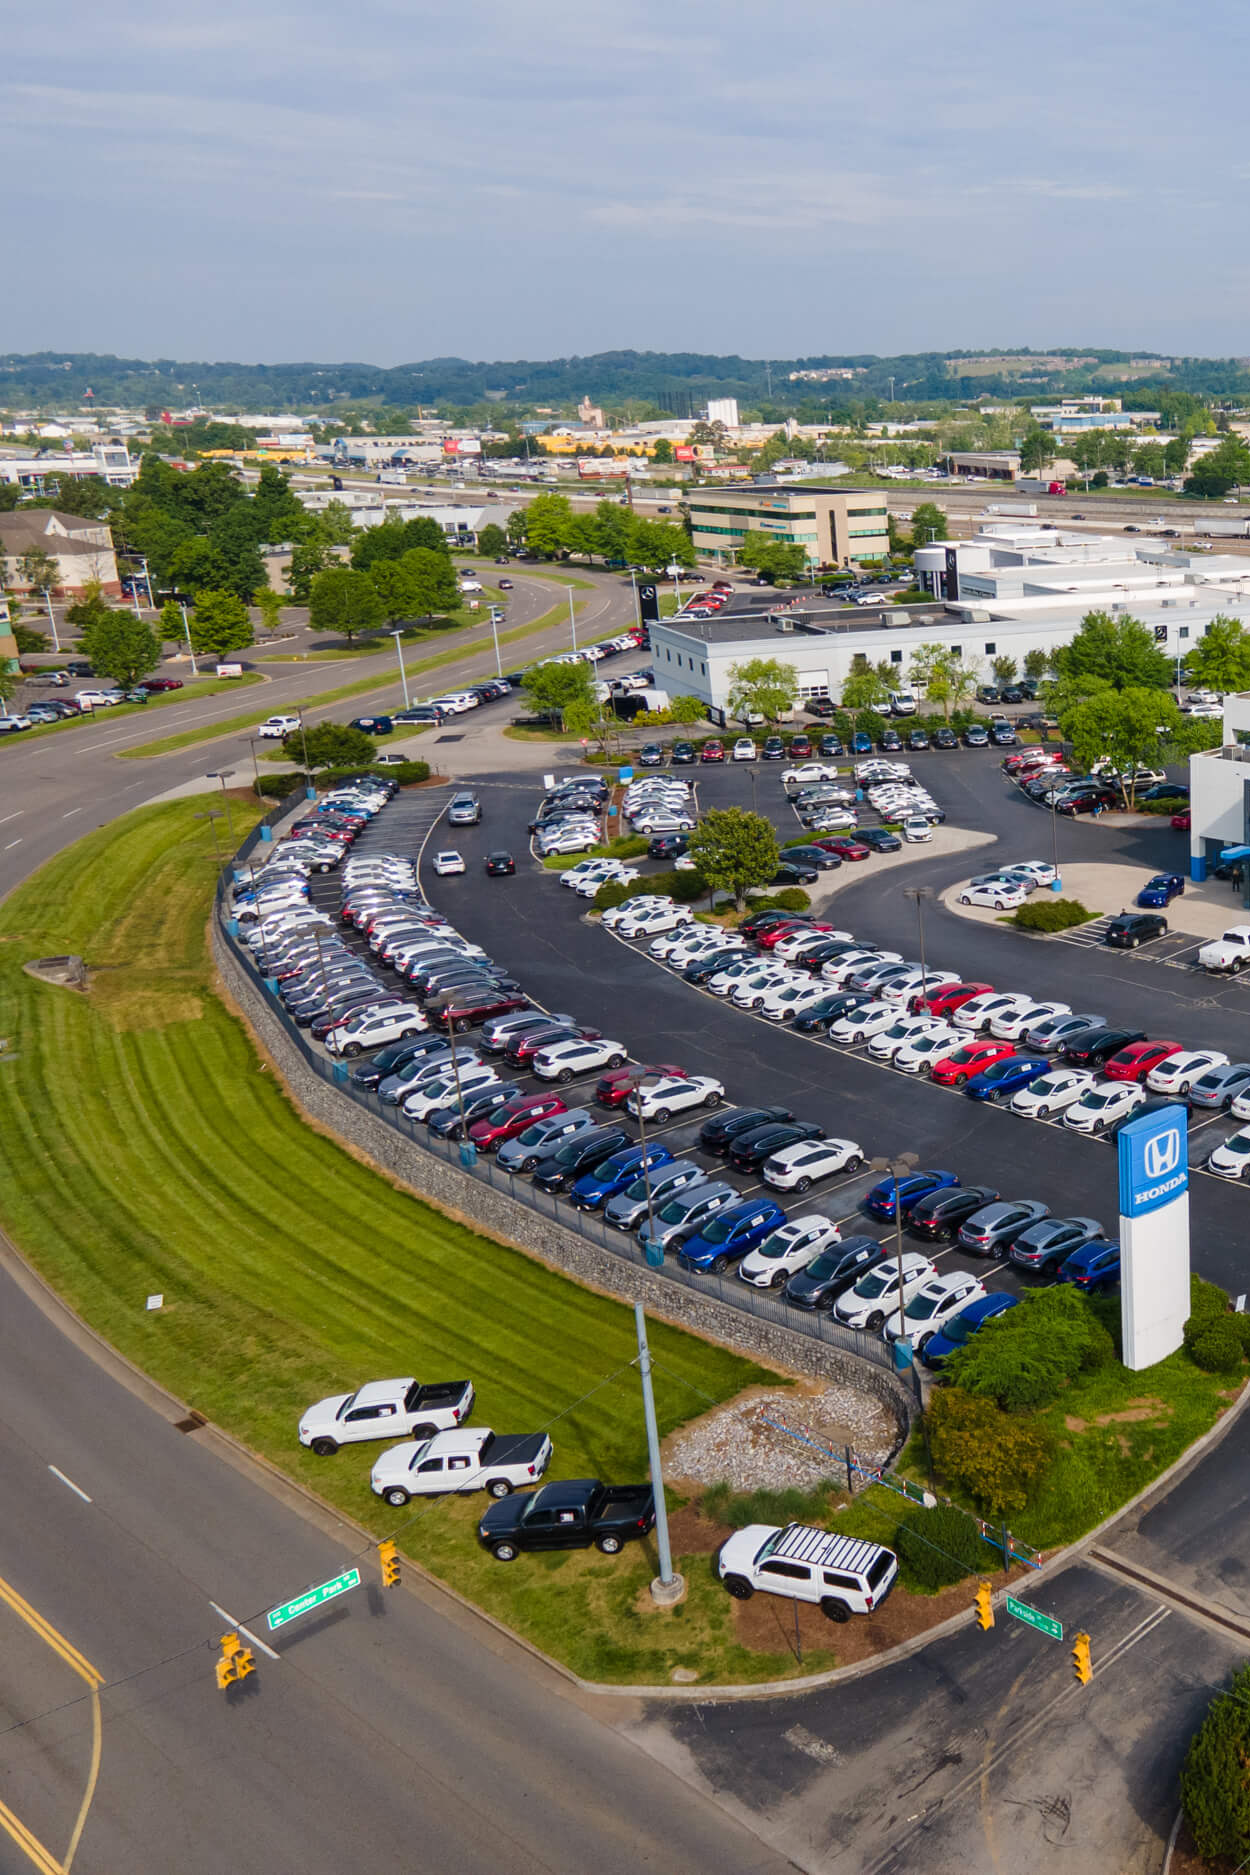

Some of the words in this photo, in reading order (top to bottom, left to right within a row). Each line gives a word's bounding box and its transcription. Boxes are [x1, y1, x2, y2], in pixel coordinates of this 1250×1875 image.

[1135, 1173, 1187, 1205] HONDA
[287, 1595, 317, 1615] Center
[322, 1581, 343, 1597] Park
